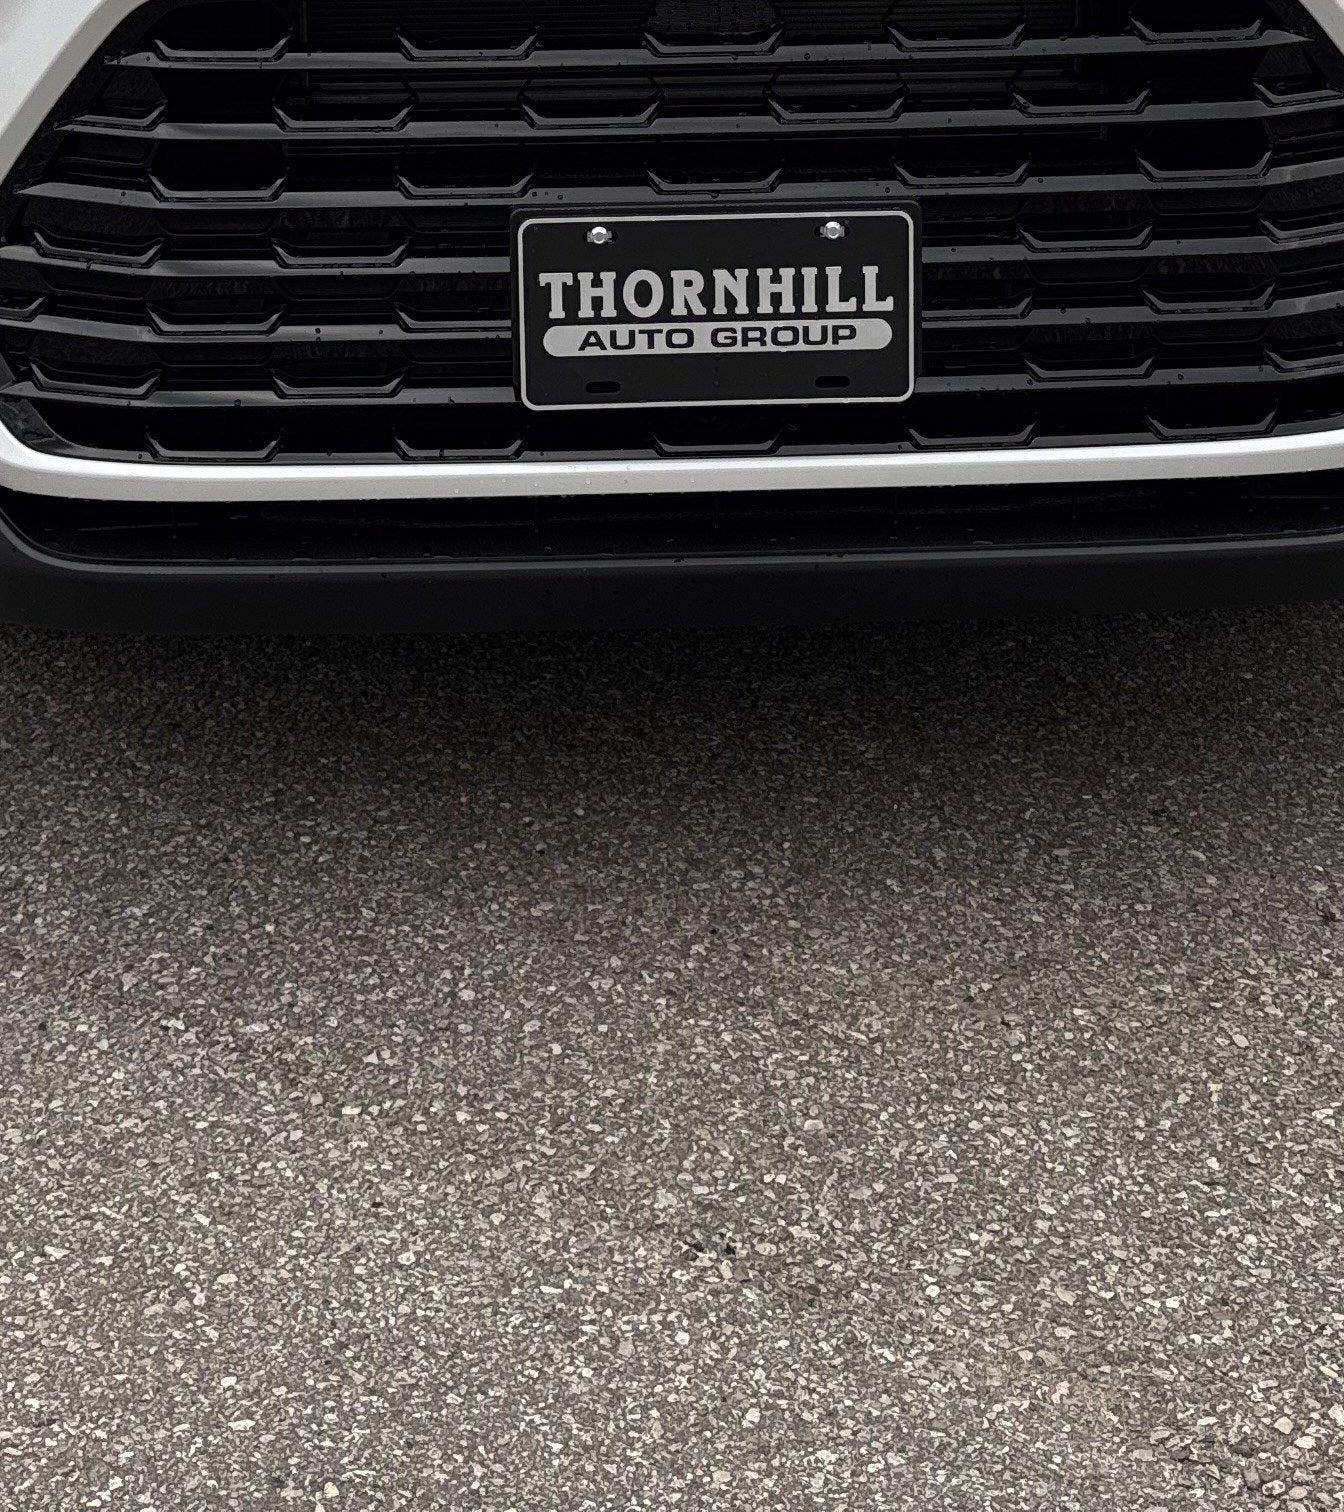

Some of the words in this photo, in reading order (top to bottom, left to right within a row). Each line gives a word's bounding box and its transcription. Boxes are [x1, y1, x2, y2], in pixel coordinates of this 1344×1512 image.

[539, 265, 894, 319] THORNHILL
[577, 327, 695, 351] AUTO
[710, 324, 857, 348] GROUP
